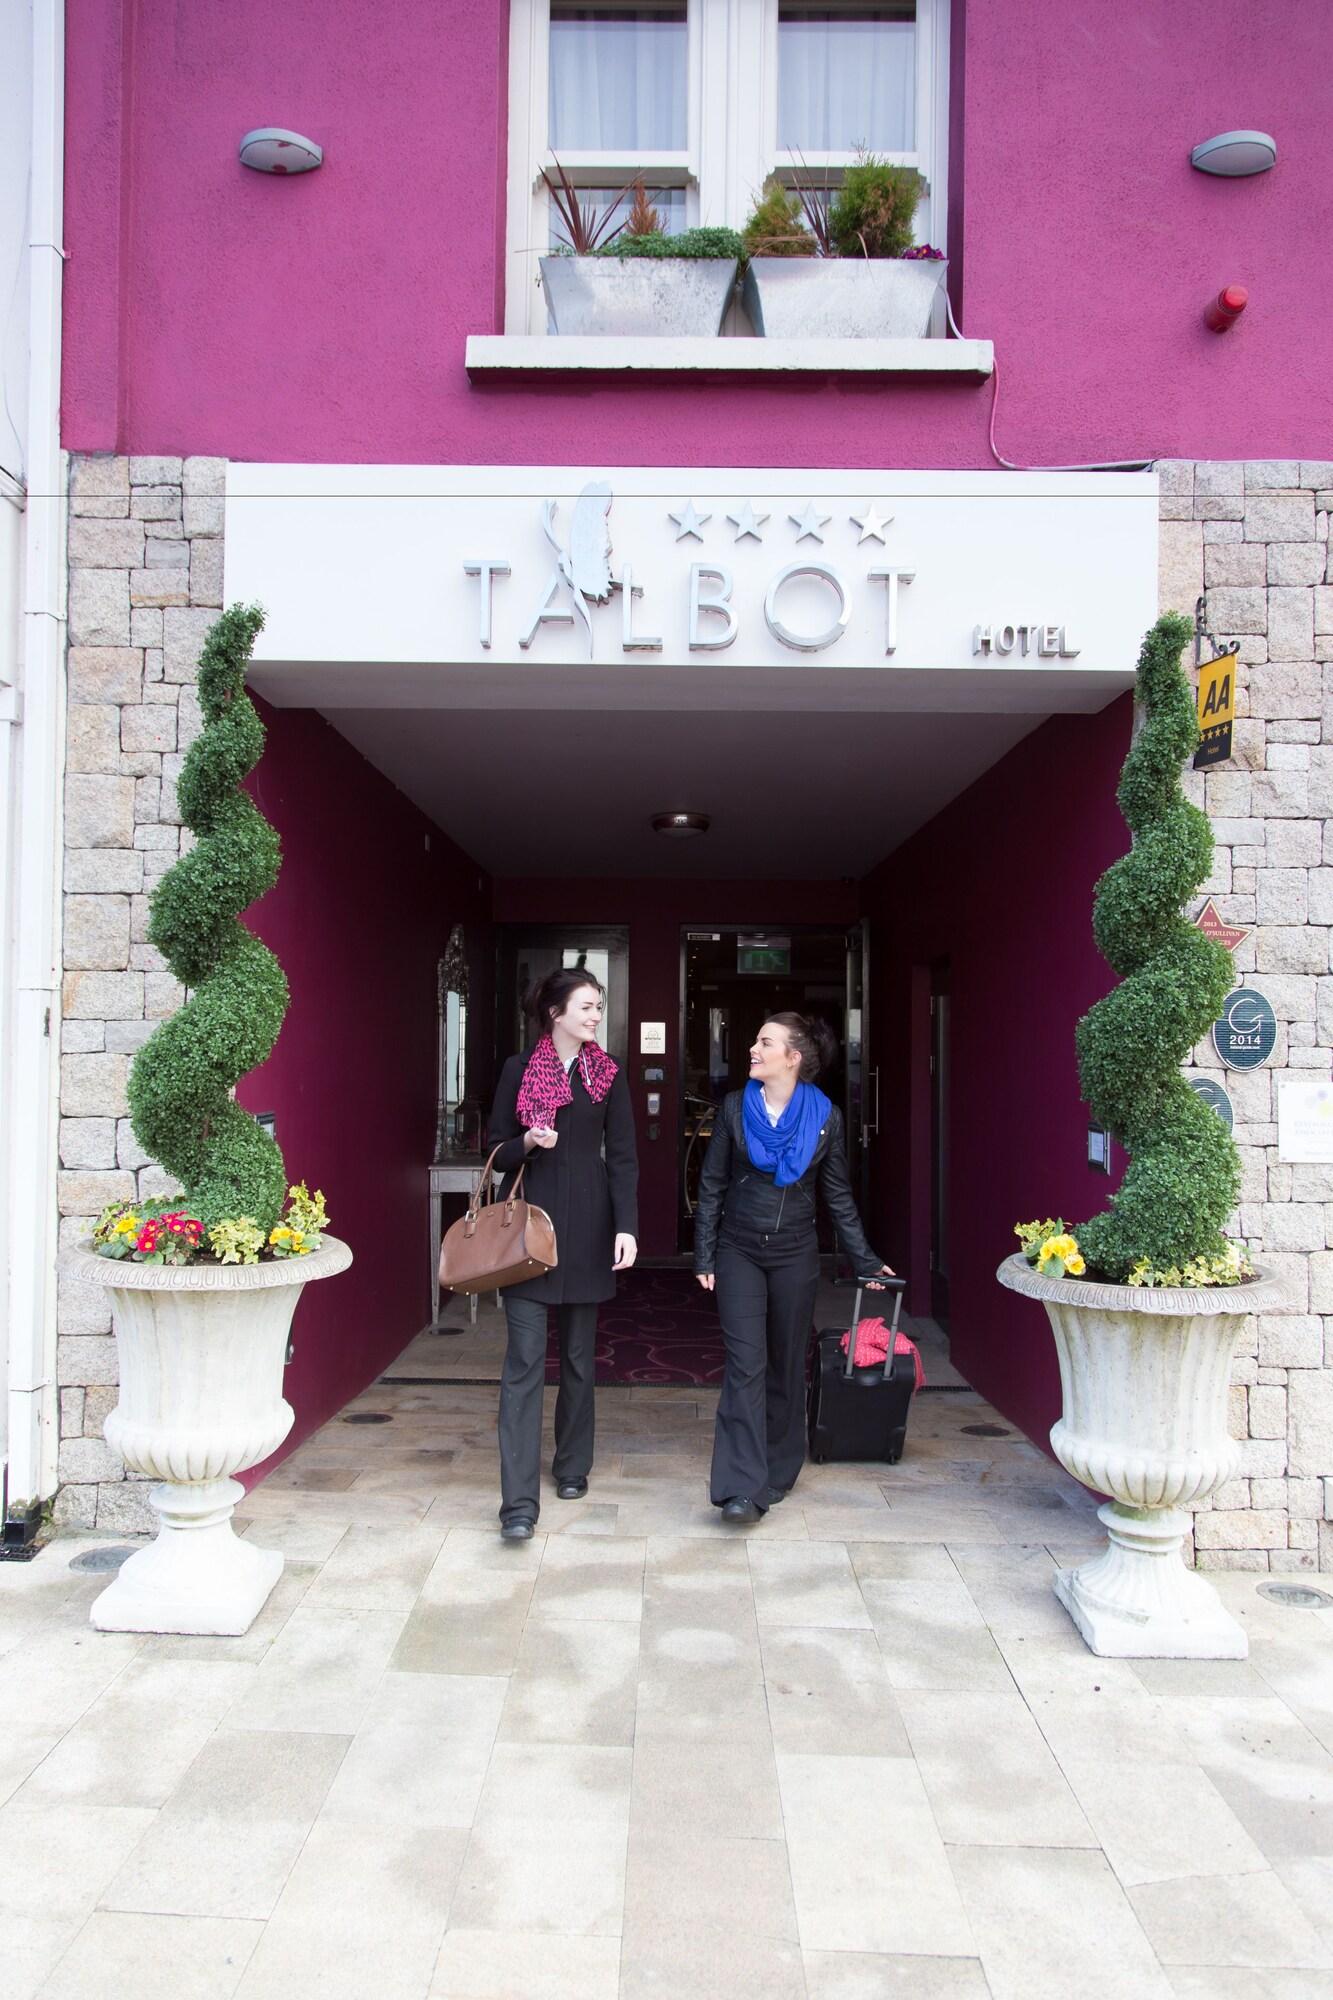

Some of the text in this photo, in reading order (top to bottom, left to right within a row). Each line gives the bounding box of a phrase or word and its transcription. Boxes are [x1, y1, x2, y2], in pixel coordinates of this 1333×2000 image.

[463, 558, 917, 657] TALBOT
[972, 624, 1081, 658] HOTEL
[1202, 674, 1230, 718] AA
[1229, 1035, 1261, 1045] 2014
